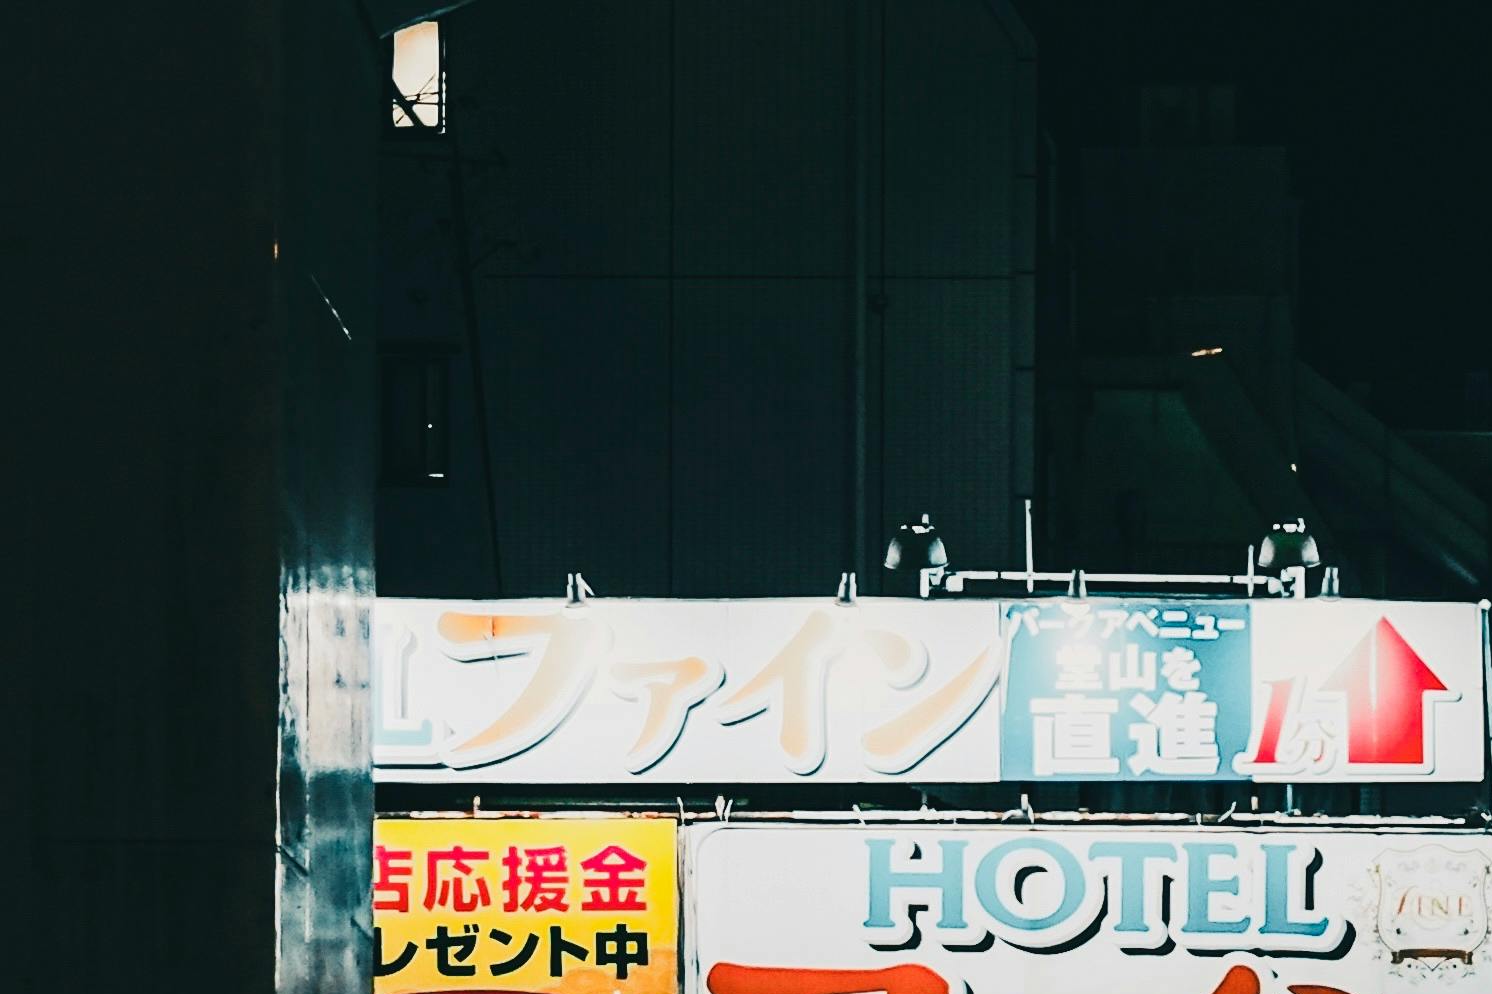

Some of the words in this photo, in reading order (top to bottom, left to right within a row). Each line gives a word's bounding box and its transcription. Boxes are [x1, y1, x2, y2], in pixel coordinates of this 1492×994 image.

[1008, 607, 1246, 640] パークアベニュー
[437, 607, 998, 767] ファイン
[1055, 643, 1202, 692] 堂山を
[1029, 693, 1220, 776] 直進
[1245, 677, 1338, 770] 1分
[864, 838, 1342, 946] HOTEL
[374, 924, 649, 980] レゼント中
